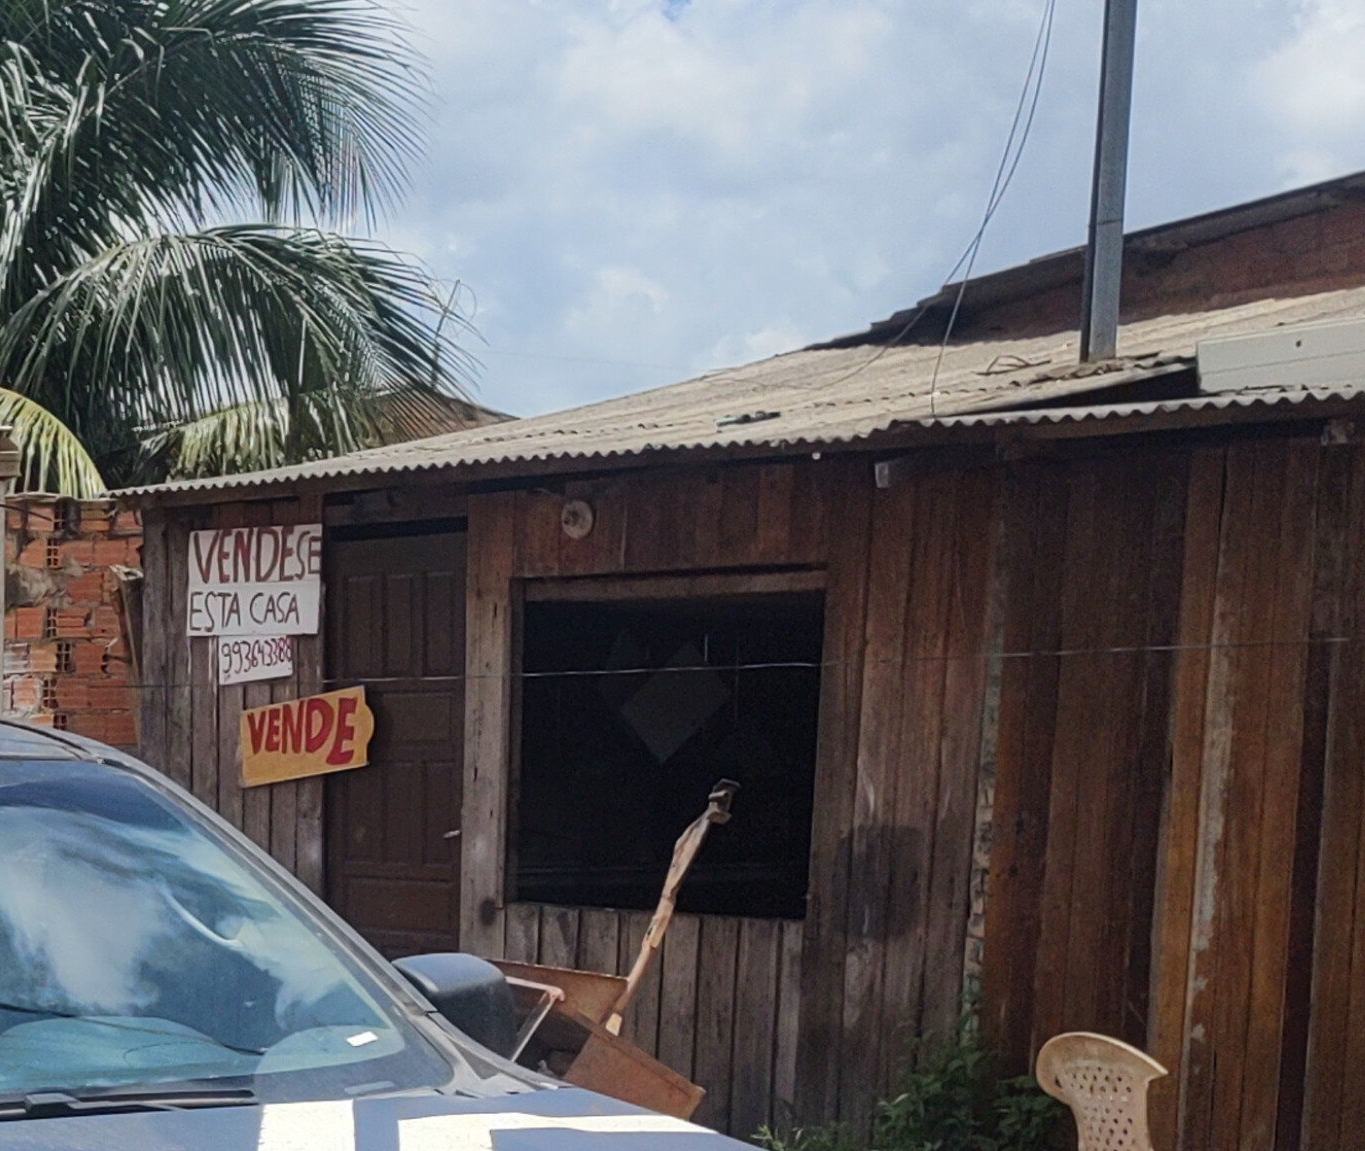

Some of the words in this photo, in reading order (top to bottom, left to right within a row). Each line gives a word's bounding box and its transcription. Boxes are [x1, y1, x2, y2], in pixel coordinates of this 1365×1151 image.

[193, 526, 322, 584] VENDESE
[189, 591, 241, 632] ESTA
[249, 592, 299, 625] CASA
[247, 697, 358, 765] VENDE
